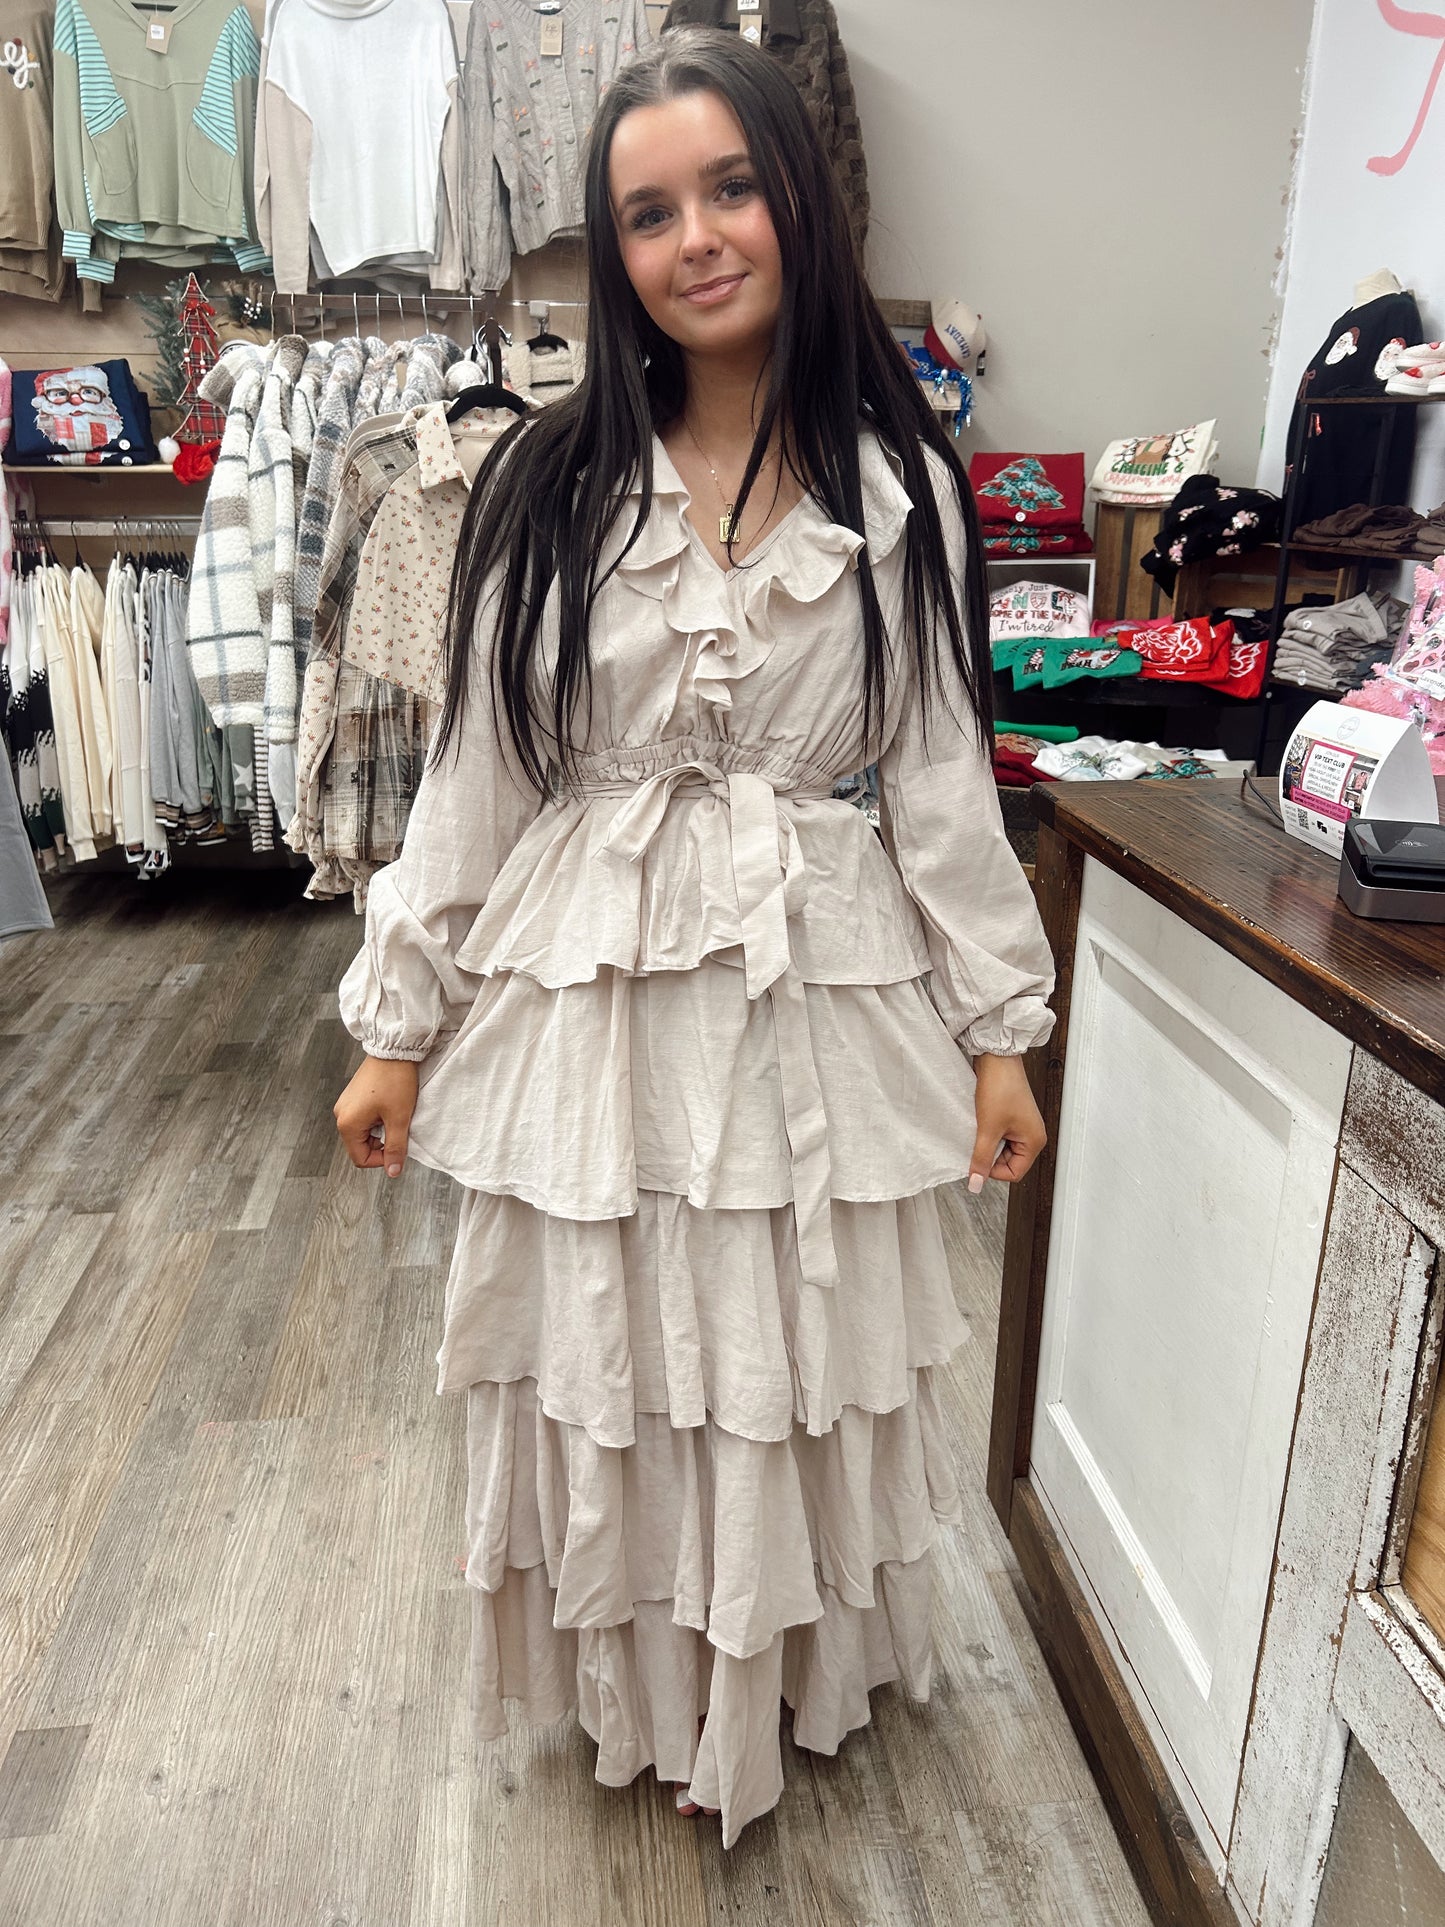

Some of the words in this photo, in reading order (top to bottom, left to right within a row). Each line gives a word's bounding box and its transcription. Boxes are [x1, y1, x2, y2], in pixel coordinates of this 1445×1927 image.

[1015, 610, 1028, 619] OF
[1031, 610, 1049, 620] THE
[1052, 611, 1073, 624] WAY
[1023, 619, 1055, 632] tired
[1322, 756, 1333, 764] TEXT
[1333, 760, 1346, 769] CLUB
